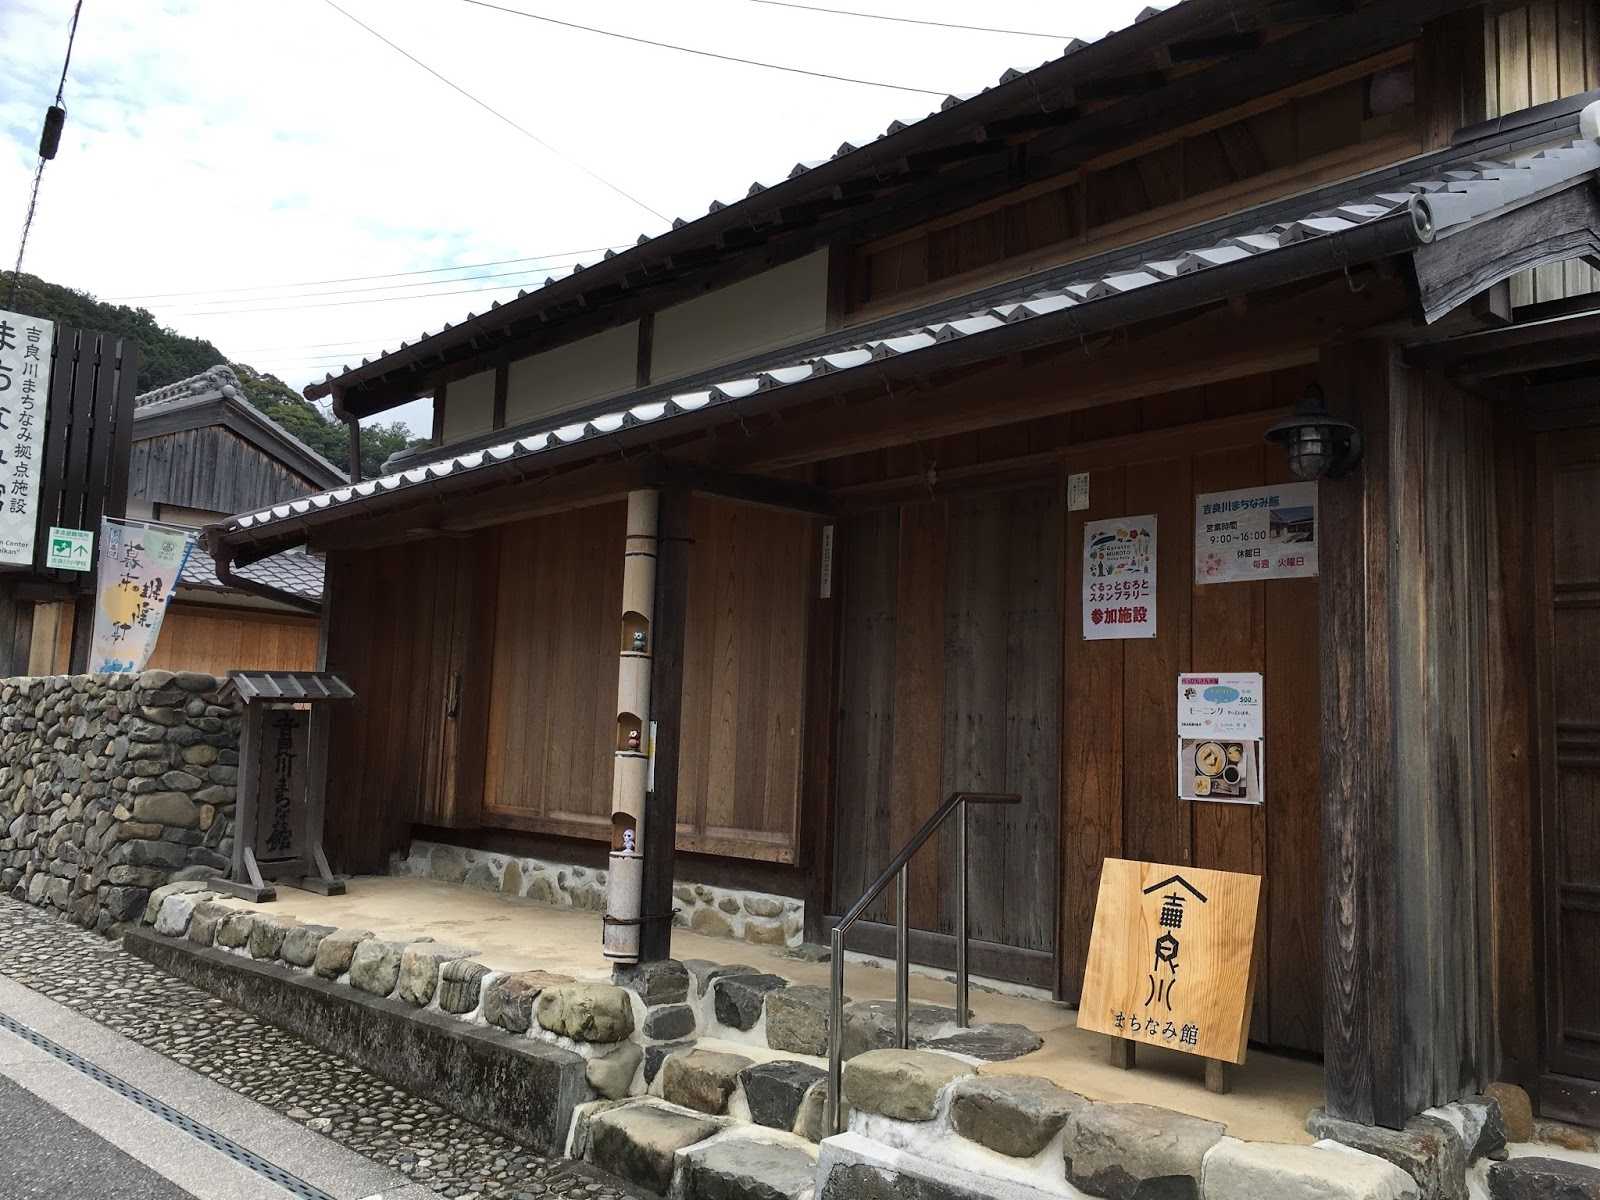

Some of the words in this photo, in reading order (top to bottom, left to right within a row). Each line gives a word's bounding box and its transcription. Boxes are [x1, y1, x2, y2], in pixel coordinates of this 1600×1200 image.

[9, 325, 42, 515] 吉良川まちなみ拠点施設
[1203, 495, 1281, 515] 吉良川まちなみ館
[1206, 521, 1238, 533] 営業時間
[1237, 548, 1261, 560] 休館日
[1253, 559, 1269, 569] 毎週
[1278, 557, 1305, 568] 火曜日
[1090, 579, 1149, 592] ぐるっとむろと
[1089, 590, 1149, 602] スタンプラリー
[1091, 606, 1148, 625] 参加施設
[1112, 1011, 1199, 1046] まちなみ館
